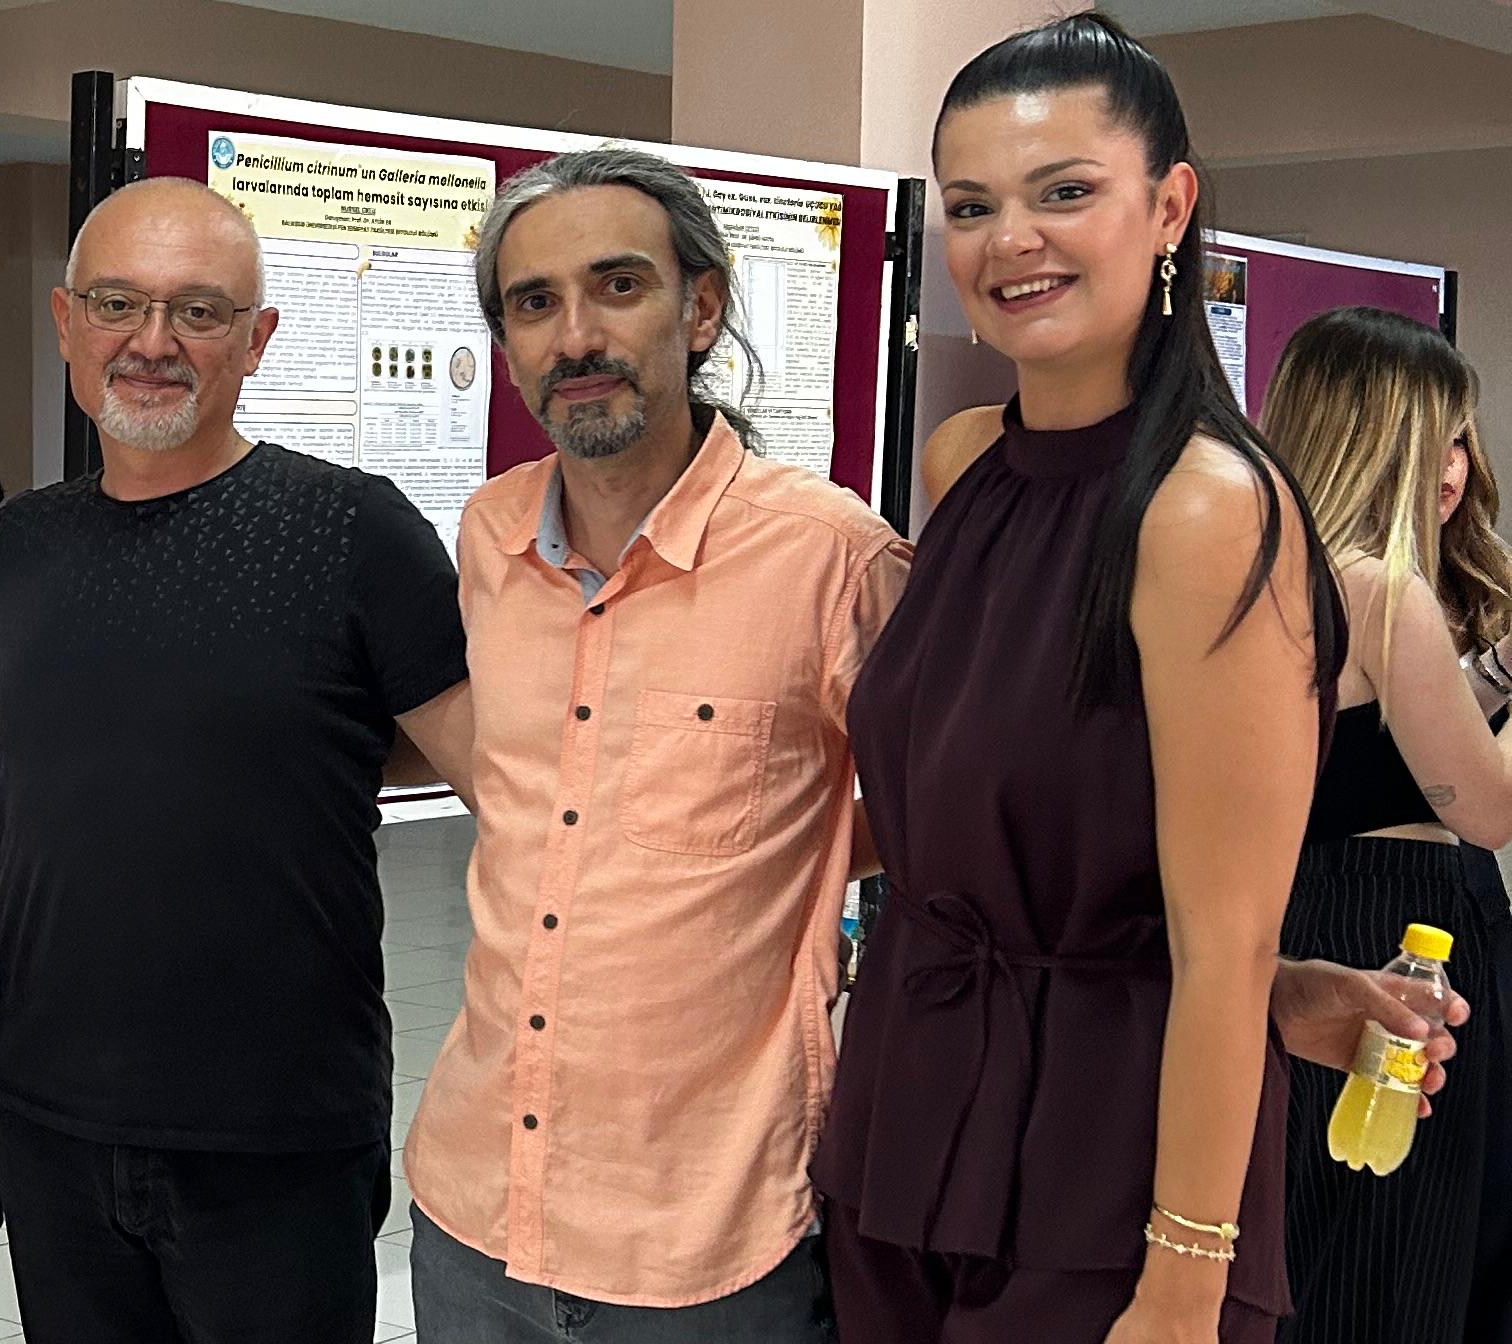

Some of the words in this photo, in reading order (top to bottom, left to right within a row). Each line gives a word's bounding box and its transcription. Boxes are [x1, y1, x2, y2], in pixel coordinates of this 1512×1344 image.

[236, 153, 304, 174] Penicillium
[378, 168, 426, 185] Galleria
[428, 173, 487, 190] mellonella
[232, 176, 309, 197] larvalarında
[311, 185, 354, 203] toplam
[357, 188, 405, 206] hemosit
[407, 196, 458, 212] sayısına
